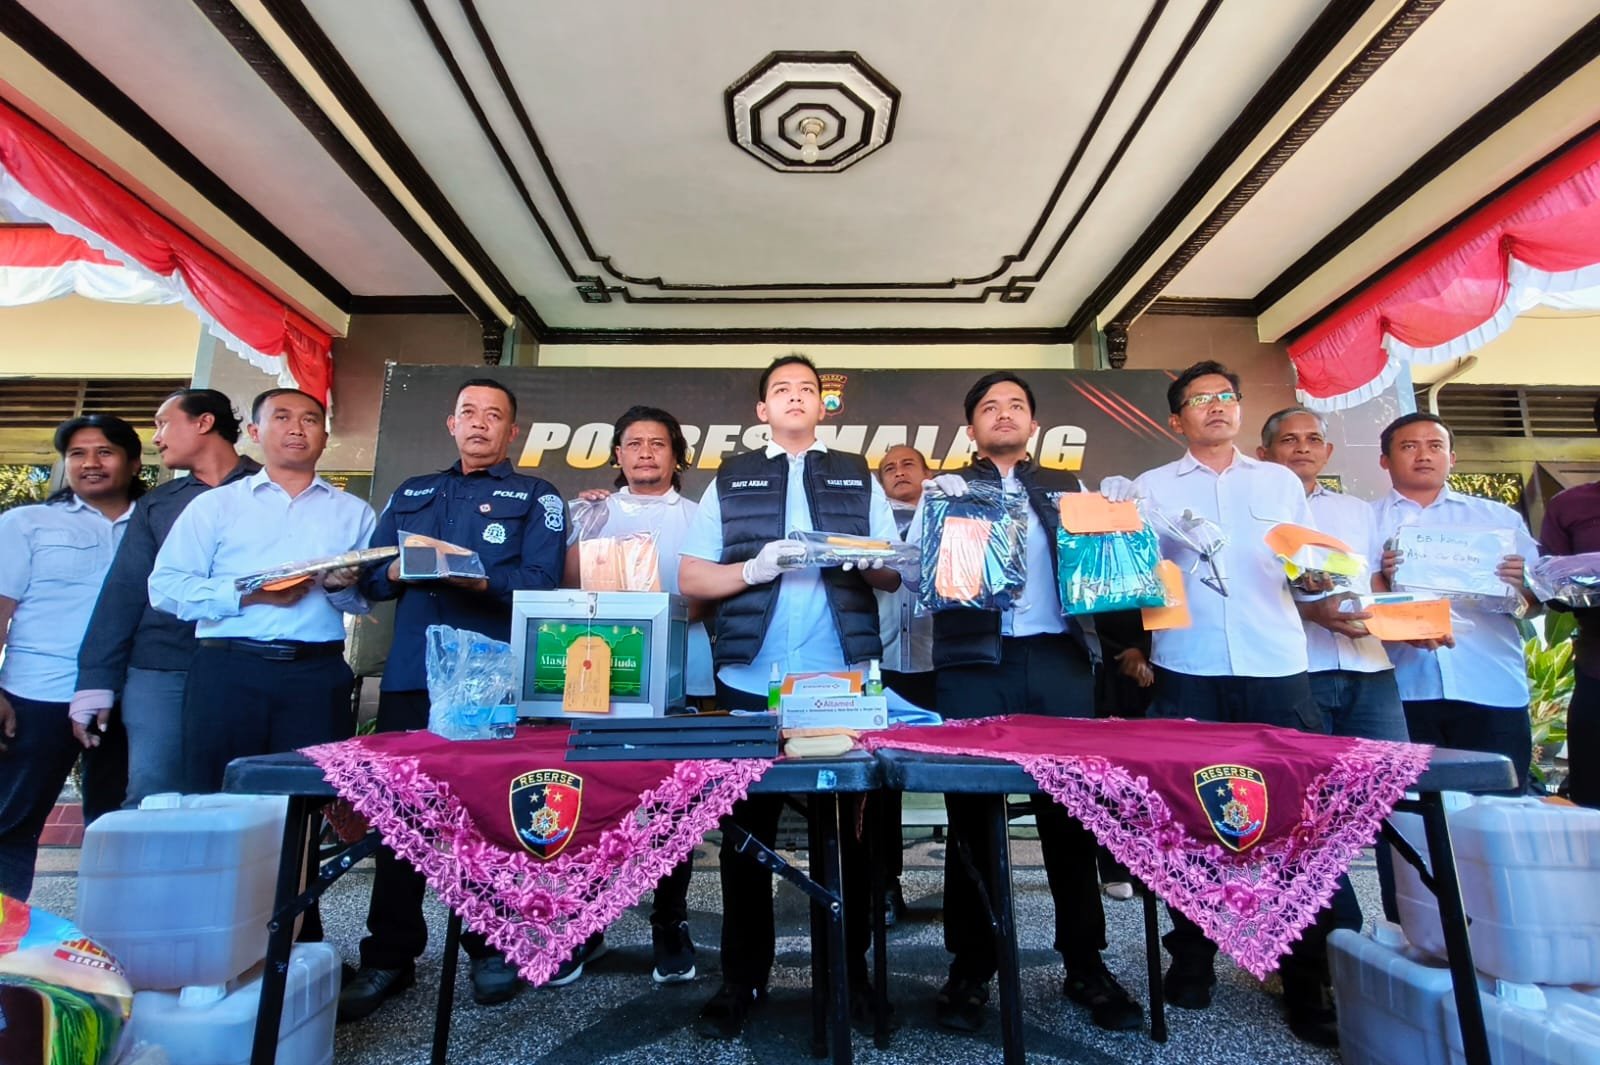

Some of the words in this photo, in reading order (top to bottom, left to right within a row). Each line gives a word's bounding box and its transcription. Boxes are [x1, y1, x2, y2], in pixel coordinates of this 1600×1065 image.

[518, 422, 773, 469] POES
[815, 424, 1088, 471] MALAG
[492, 490, 529, 501] POLRI
[540, 655, 568, 667] Masj
[519, 772, 576, 786] RESERSE
[1200, 767, 1255, 782] RESERSE
[67, 953, 106, 969] BERAS
